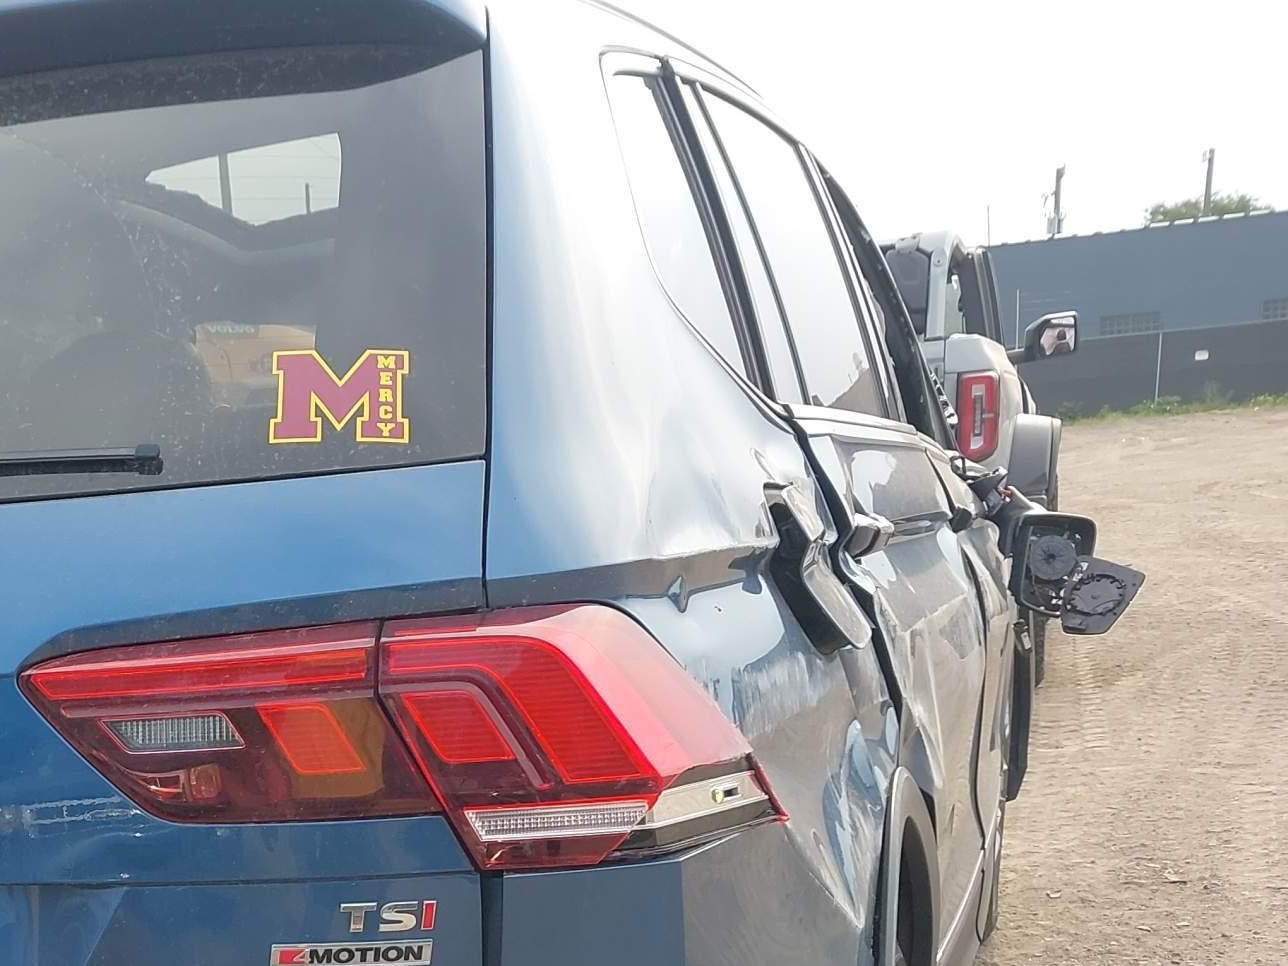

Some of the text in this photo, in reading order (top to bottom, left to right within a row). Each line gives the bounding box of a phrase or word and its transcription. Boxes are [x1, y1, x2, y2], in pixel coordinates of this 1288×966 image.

[377, 355, 396, 436] MERCY
[340, 900, 437, 932] TSI
[278, 946, 423, 966] 4MOTION
